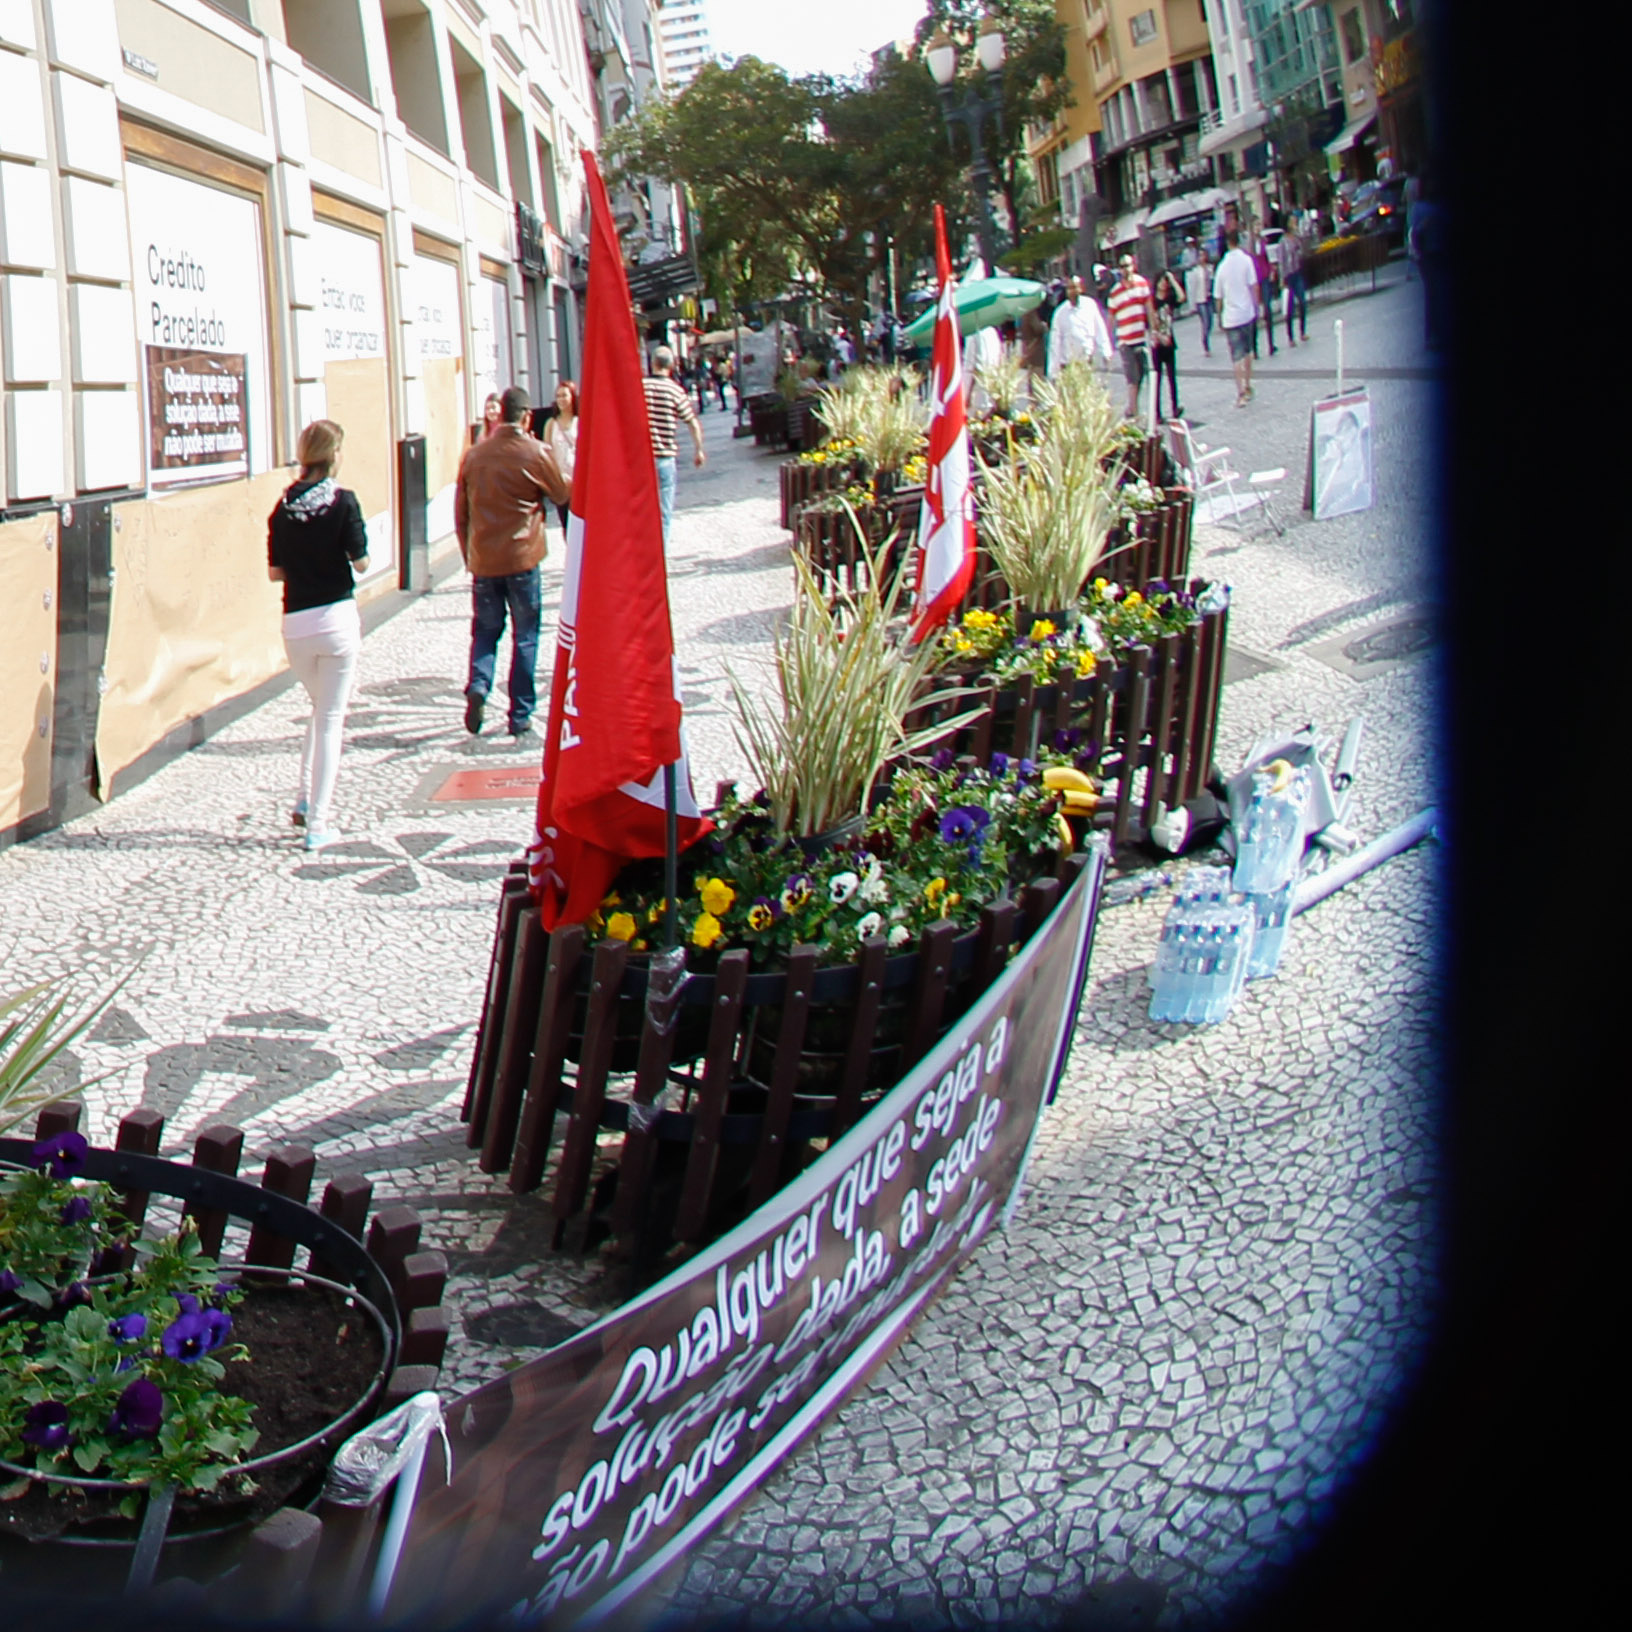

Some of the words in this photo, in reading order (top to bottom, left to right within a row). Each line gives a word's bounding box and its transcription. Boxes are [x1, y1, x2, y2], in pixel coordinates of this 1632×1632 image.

[148, 244, 205, 292] Crédito
[152, 301, 225, 347] Parcelado
[593, 1193, 829, 1434] Qualquer
[832, 1120, 907, 1241] que
[911, 1039, 983, 1154] seja
[985, 1015, 1009, 1074] a
[532, 1342, 777, 1562] solução
[775, 1218, 893, 1365] dada,
[899, 1187, 921, 1249] a
[926, 1096, 1002, 1216] sede
[607, 1412, 752, 1580] pode
